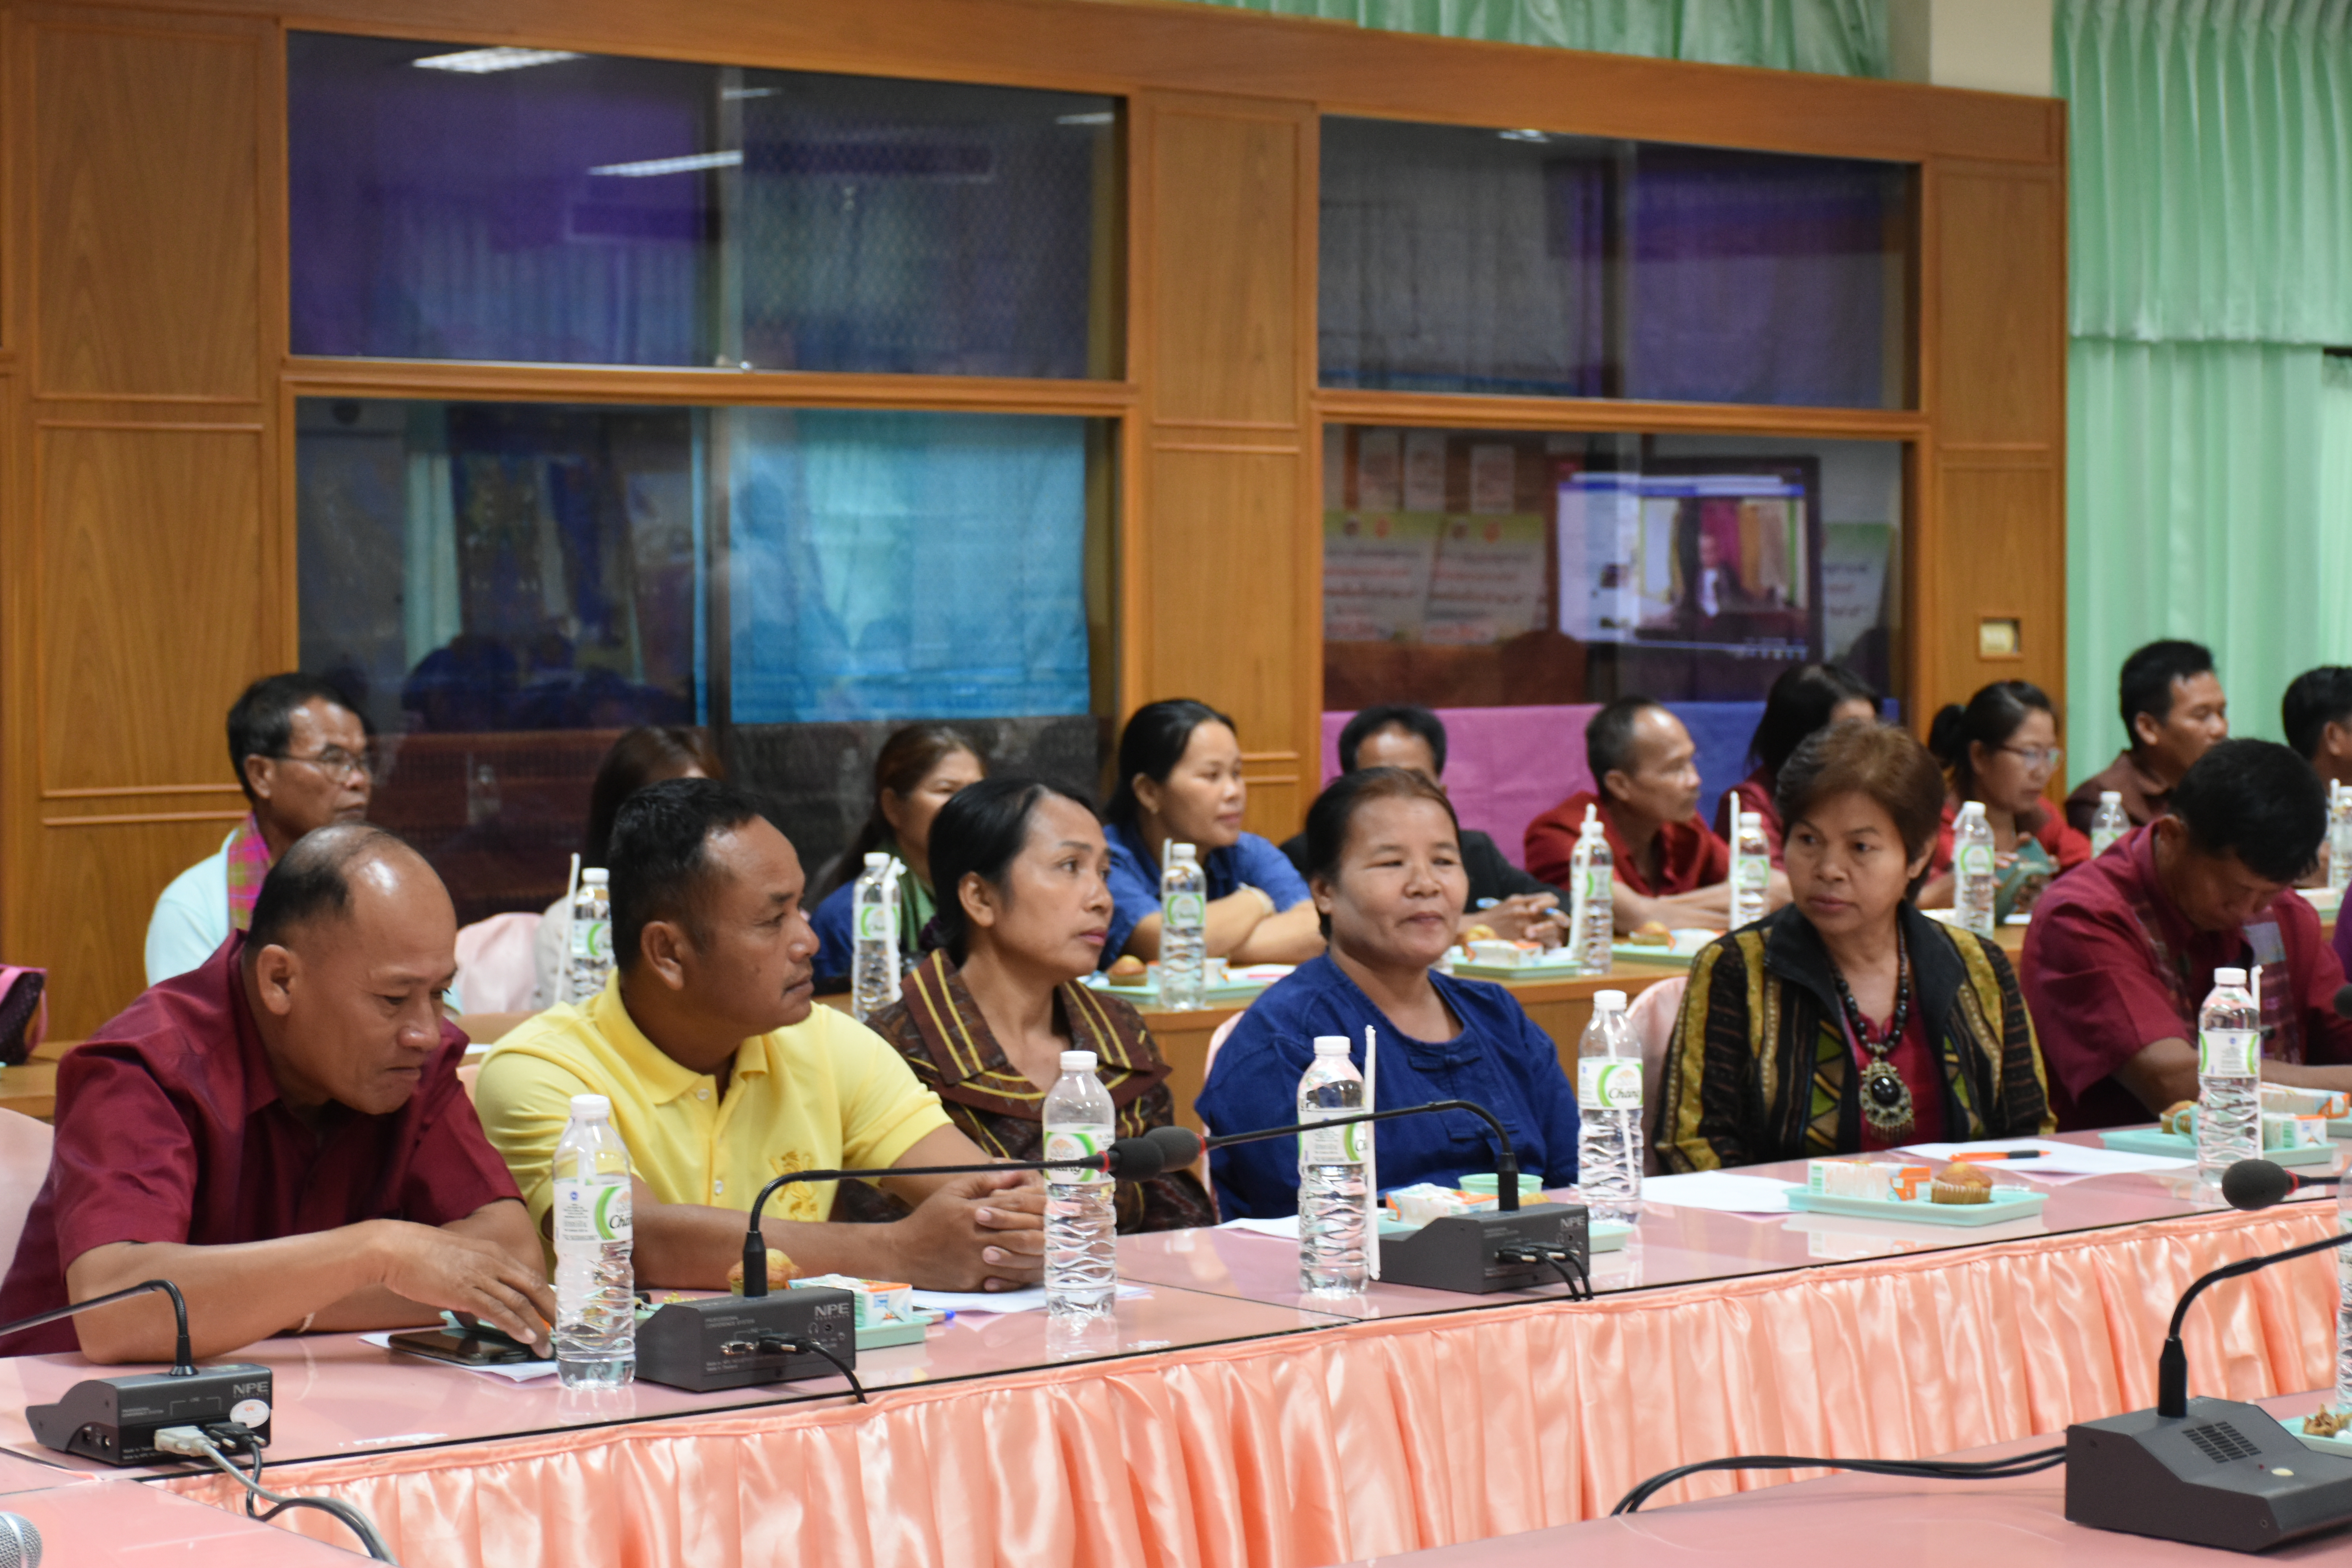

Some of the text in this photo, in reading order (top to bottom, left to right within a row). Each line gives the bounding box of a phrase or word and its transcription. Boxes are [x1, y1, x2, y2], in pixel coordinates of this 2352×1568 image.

[1560, 1216, 1586, 1228] NPE
[815, 1303, 850, 1317] NPE
[233, 1381, 269, 1395] NPE
